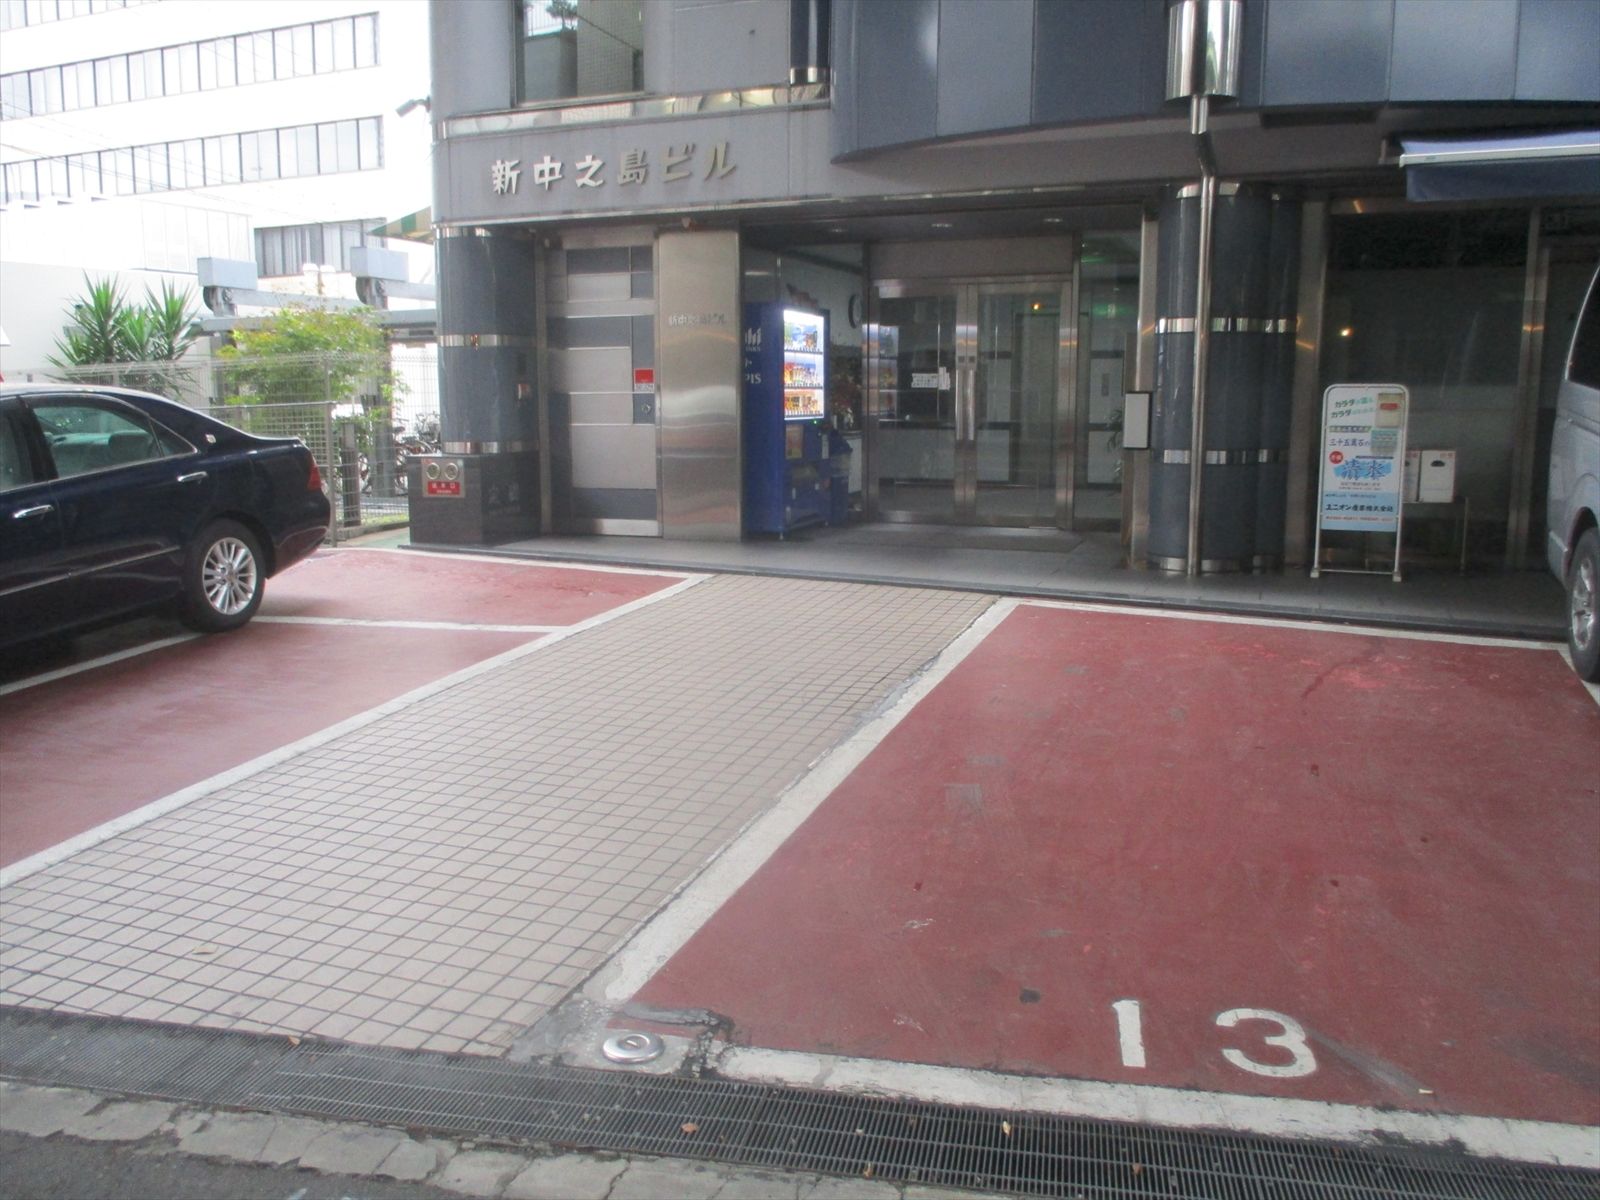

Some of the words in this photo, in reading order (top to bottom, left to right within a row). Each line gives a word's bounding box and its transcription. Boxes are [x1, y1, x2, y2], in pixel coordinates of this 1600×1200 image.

[490, 141, 737, 195] 新中之島ビル
[1112, 999, 1318, 1078] 13
